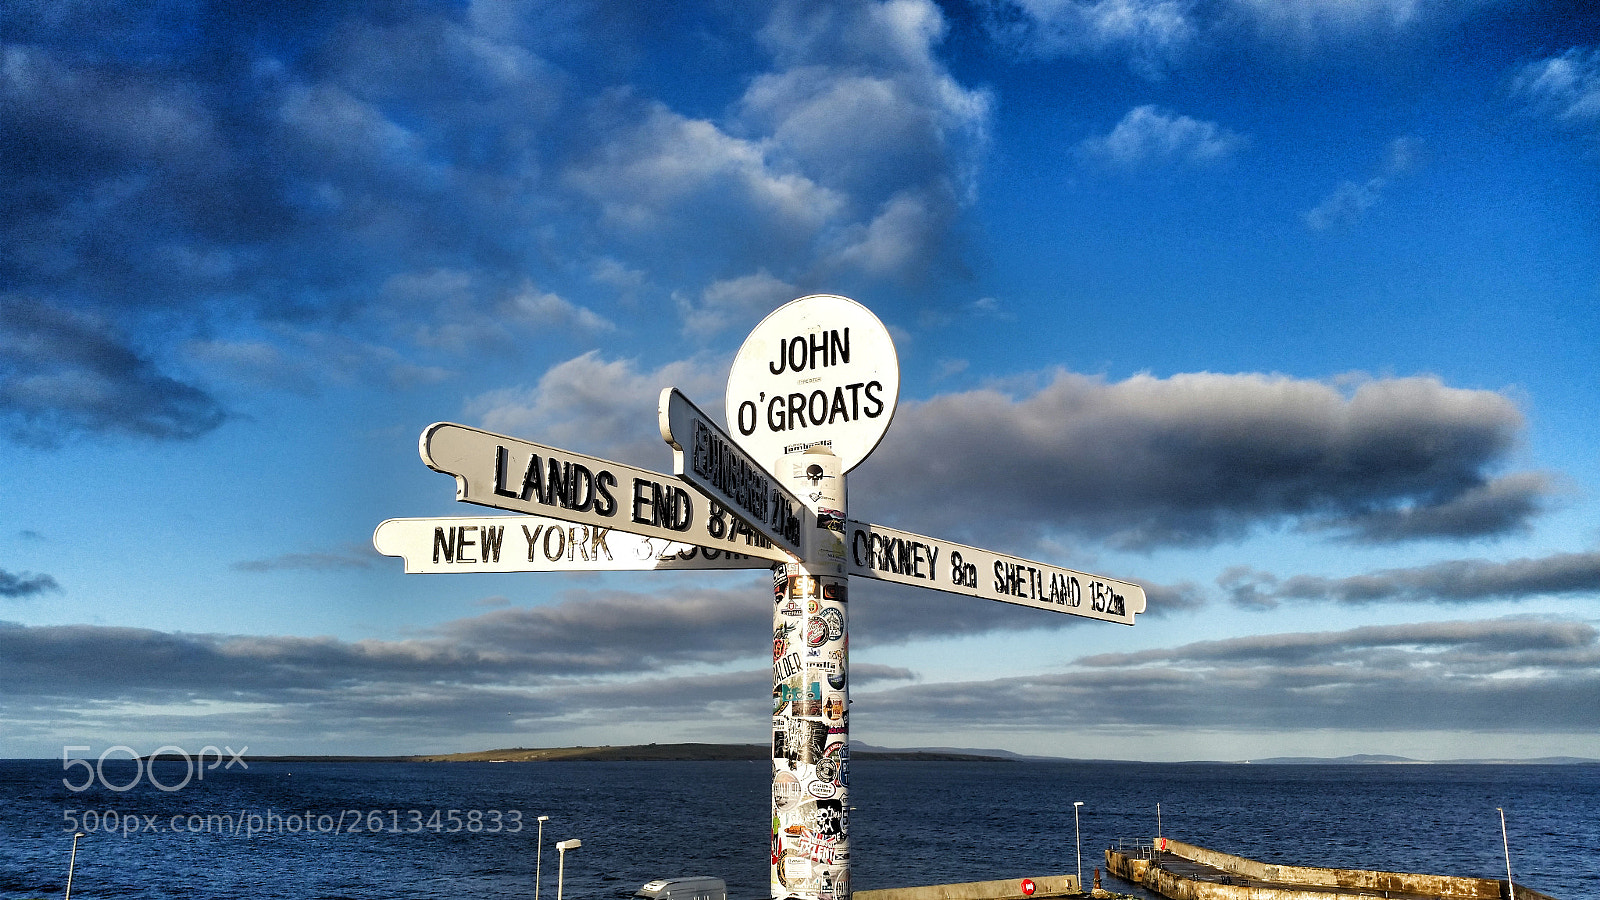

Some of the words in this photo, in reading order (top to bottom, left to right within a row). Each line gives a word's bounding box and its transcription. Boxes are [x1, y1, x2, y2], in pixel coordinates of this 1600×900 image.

[769, 327, 850, 375] JOHN
[738, 381, 884, 436] O'GROATS
[493, 445, 618, 517] LANDS
[632, 477, 693, 532] END
[433, 525, 504, 564] NEW
[521, 524, 614, 562] YORK
[853, 529, 939, 581] ORKNEY
[951, 550, 977, 589] 8m
[993, 559, 1081, 608] SHETLAND
[1088, 580, 1126, 617] 152m
